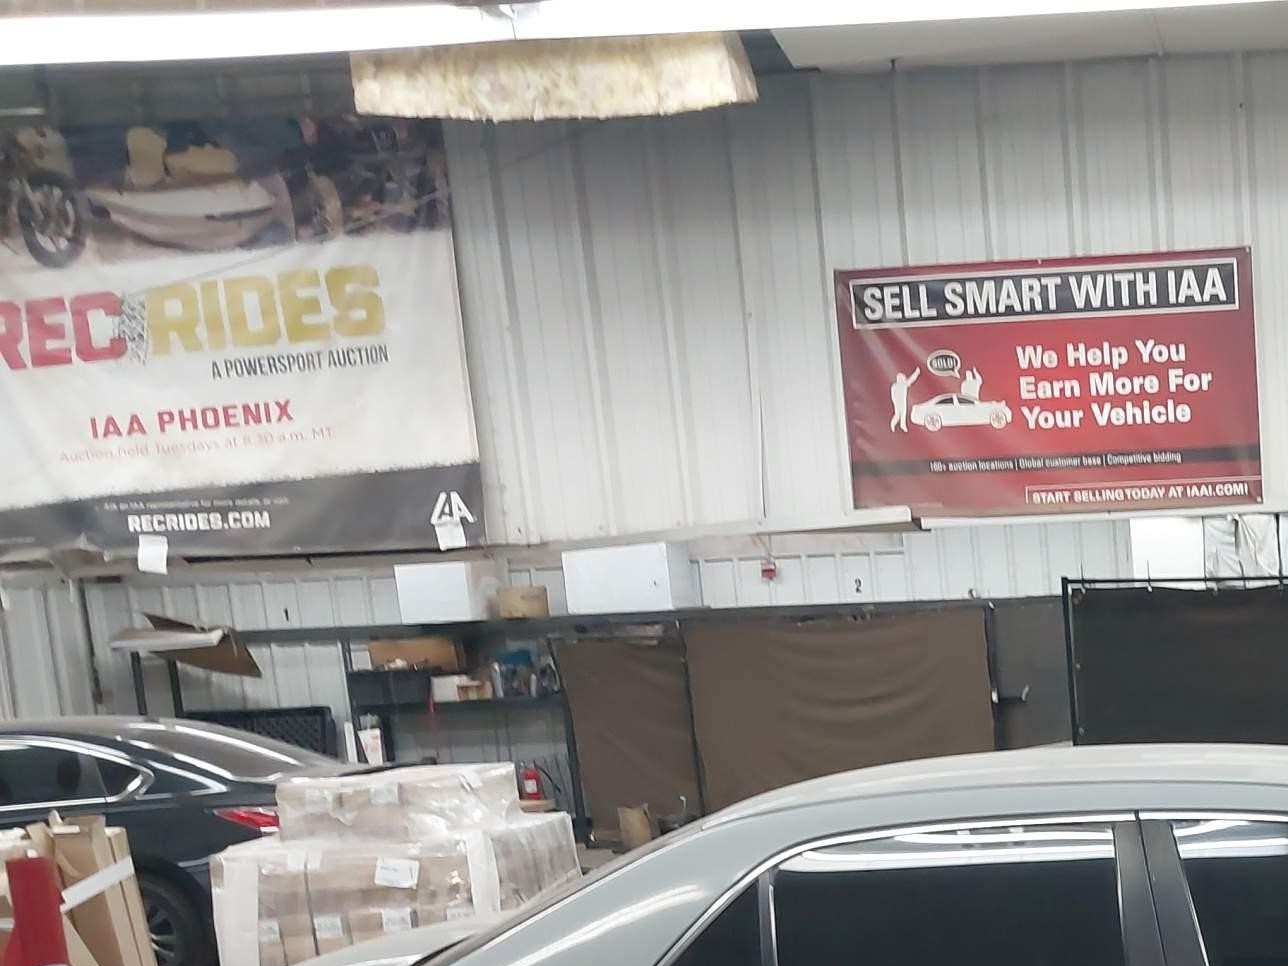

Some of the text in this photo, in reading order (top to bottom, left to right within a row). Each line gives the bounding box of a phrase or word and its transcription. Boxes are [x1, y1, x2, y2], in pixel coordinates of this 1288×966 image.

[864, 267, 1228, 321] SELL SMART WITH IAA
[146, 265, 386, 358] RIDES
[211, 344, 389, 380] A POWERSPORT AUCTION
[1016, 339, 1186, 370] We Help You
[1019, 368, 1212, 399] Earn More For
[90, 399, 295, 440] IAA PHOENIX
[1021, 399, 1192, 429] Your Vehicle
[1107, 452, 1152, 466] Competitive
[1153, 451, 1182, 464] bidding
[1033, 490, 1071, 504] START
[1074, 488, 1124, 503] SELLING
[1125, 485, 1165, 500] TODAY
[1168, 485, 1184, 498] AT
[128, 510, 270, 533] RECRIDES.COM
[854, 578, 862, 593] 2
